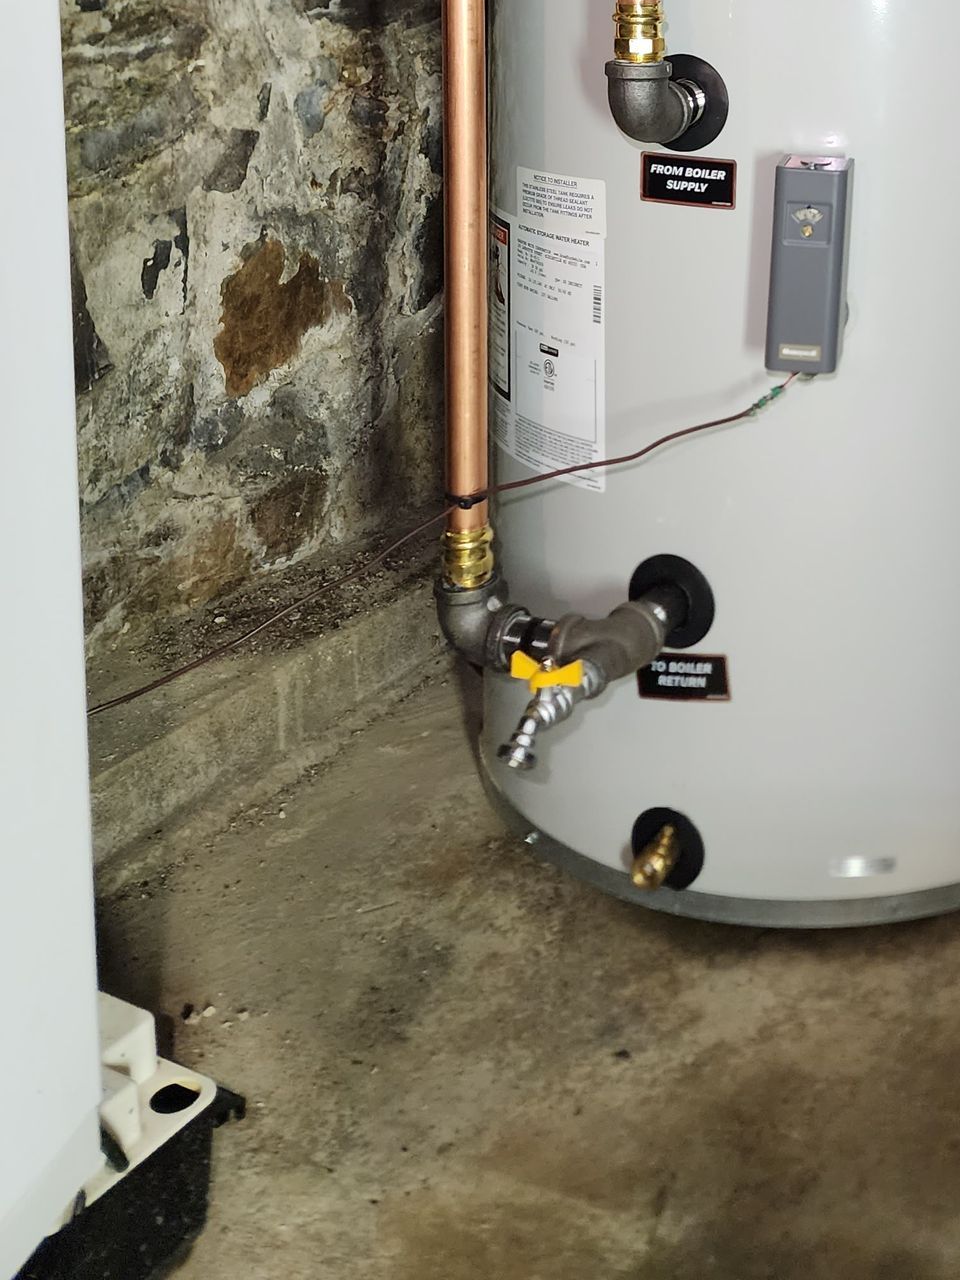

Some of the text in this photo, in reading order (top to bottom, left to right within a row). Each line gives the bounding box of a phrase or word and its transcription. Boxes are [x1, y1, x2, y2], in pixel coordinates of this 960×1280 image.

[650, 164, 726, 180] FROM BOILER
[666, 180, 708, 192] SUPPLY
[651, 660, 712, 674] TO BOILER
[658, 675, 706, 688] RETURN
